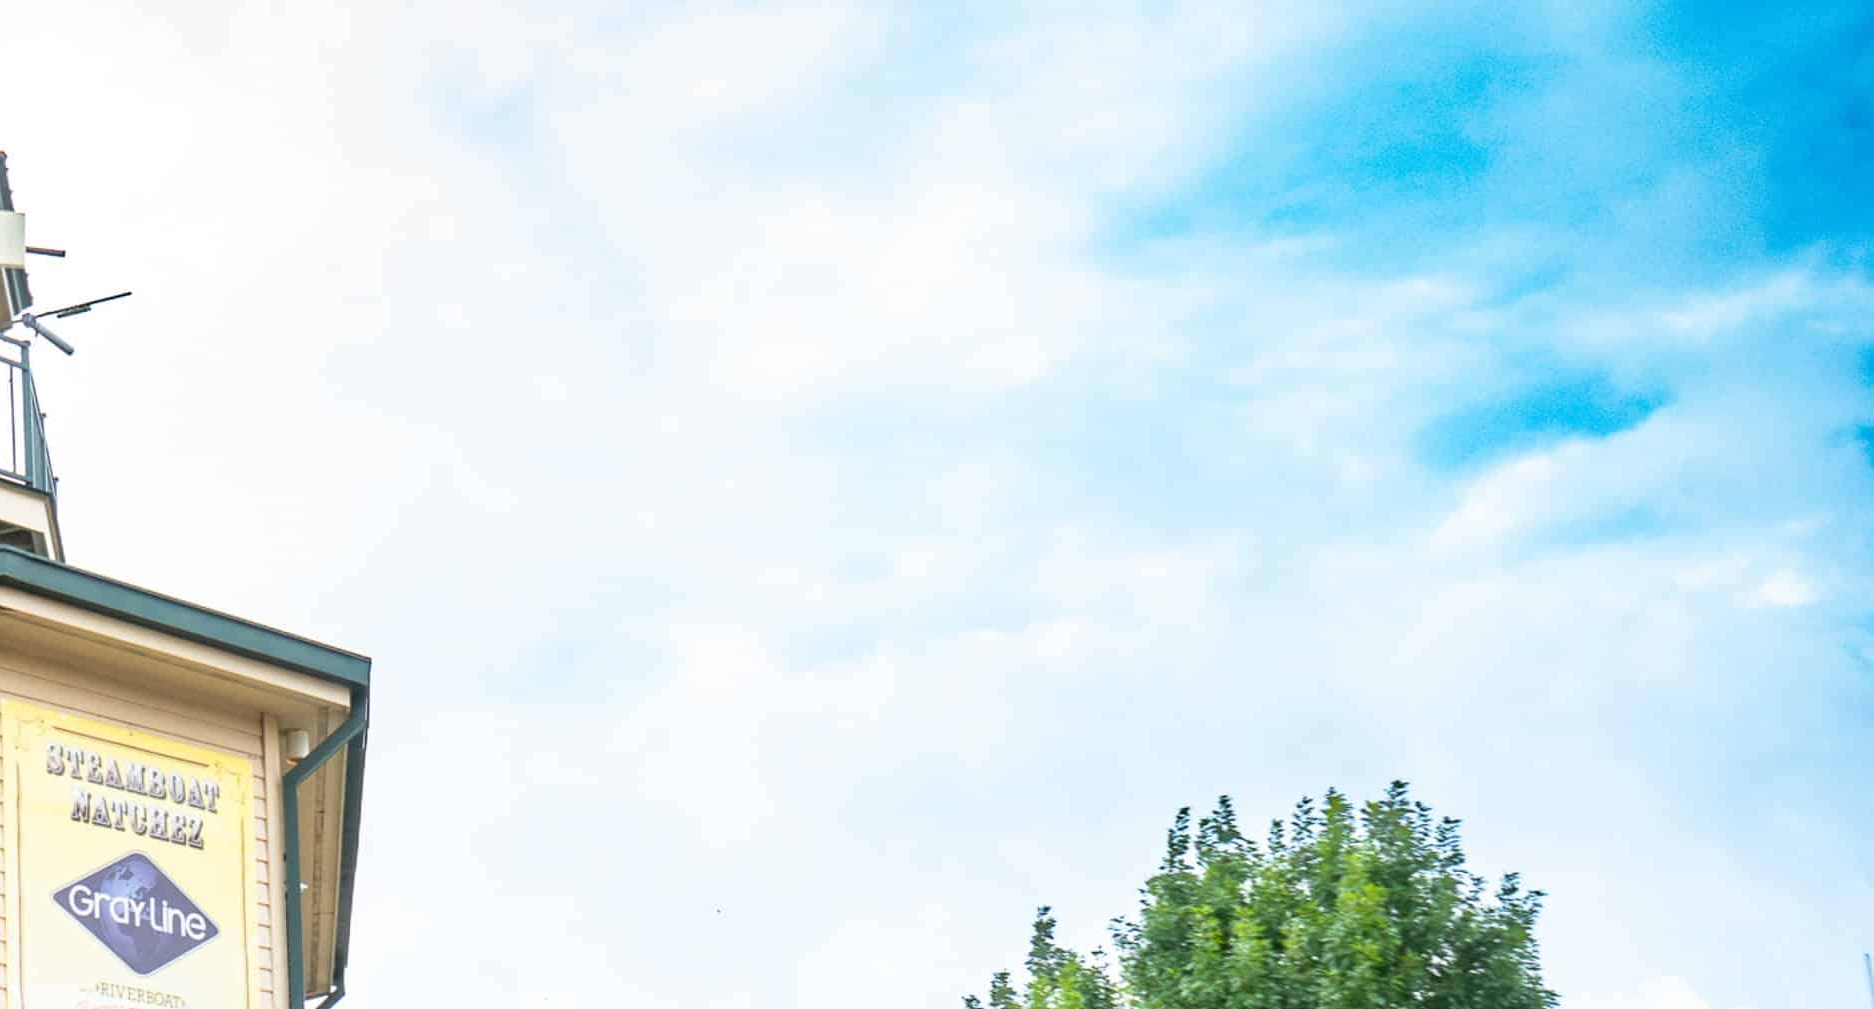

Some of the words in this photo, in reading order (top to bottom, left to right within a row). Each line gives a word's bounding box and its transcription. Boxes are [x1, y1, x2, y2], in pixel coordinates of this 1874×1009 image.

[46, 743, 220, 814] STEAMBOAT
[70, 792, 204, 850] NATCHEZ
[101, 982, 183, 1009] RIVERBOAT
